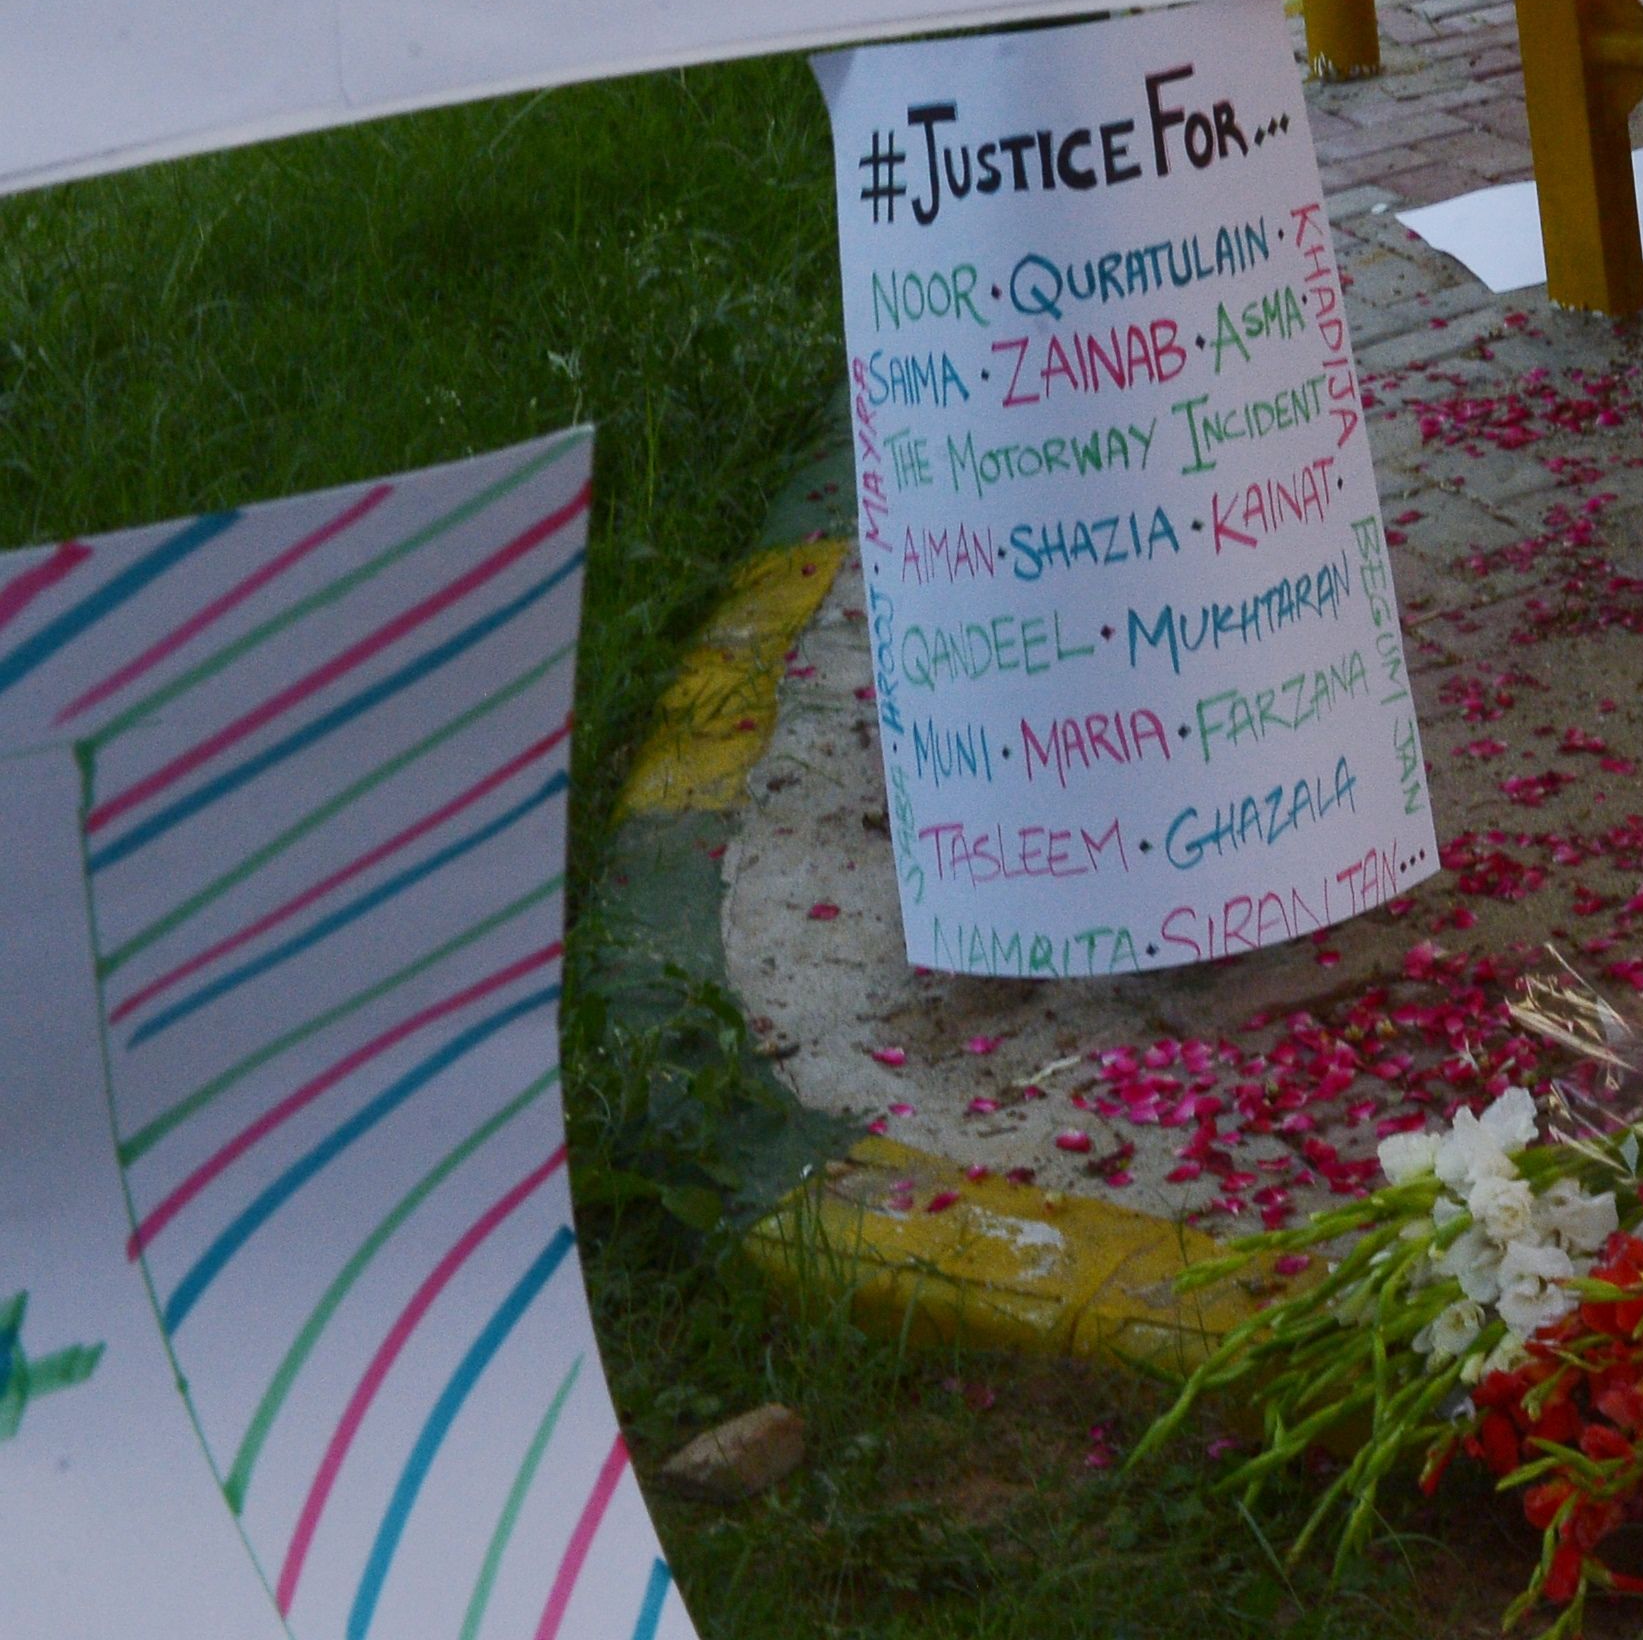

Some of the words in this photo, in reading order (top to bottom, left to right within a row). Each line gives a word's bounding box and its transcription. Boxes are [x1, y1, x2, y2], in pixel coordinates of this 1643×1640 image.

[872, 262, 992, 332] NOOR
[1009, 216, 1270, 321] QURATULAIN
[1289, 203, 1358, 448] KHADIJA
[868, 348, 970, 408] SAIMA
[991, 318, 1188, 408] ZAINAB
[1209, 286, 1307, 375] ASMA
[883, 427, 933, 493] THE
[946, 416, 1157, 499] MOTORWAY
[1171, 374, 1327, 475] INCIDENT
[901, 521, 996, 585] AIMAN
[1008, 505, 1180, 582] SHAZIA
[1211, 456, 1335, 555] KAINAT
[899, 608, 1095, 692] QANDEEL
[1126, 549, 1351, 674] MUKHTARAN
[1350, 514, 1408, 706] BEGUM
[911, 719, 993, 788] MUNI
[1019, 707, 1171, 789] MARIA
[1195, 649, 1369, 764] FARZANA
[918, 817, 1130, 889] TASLEEM
[1164, 754, 1358, 872] GHAZALA
